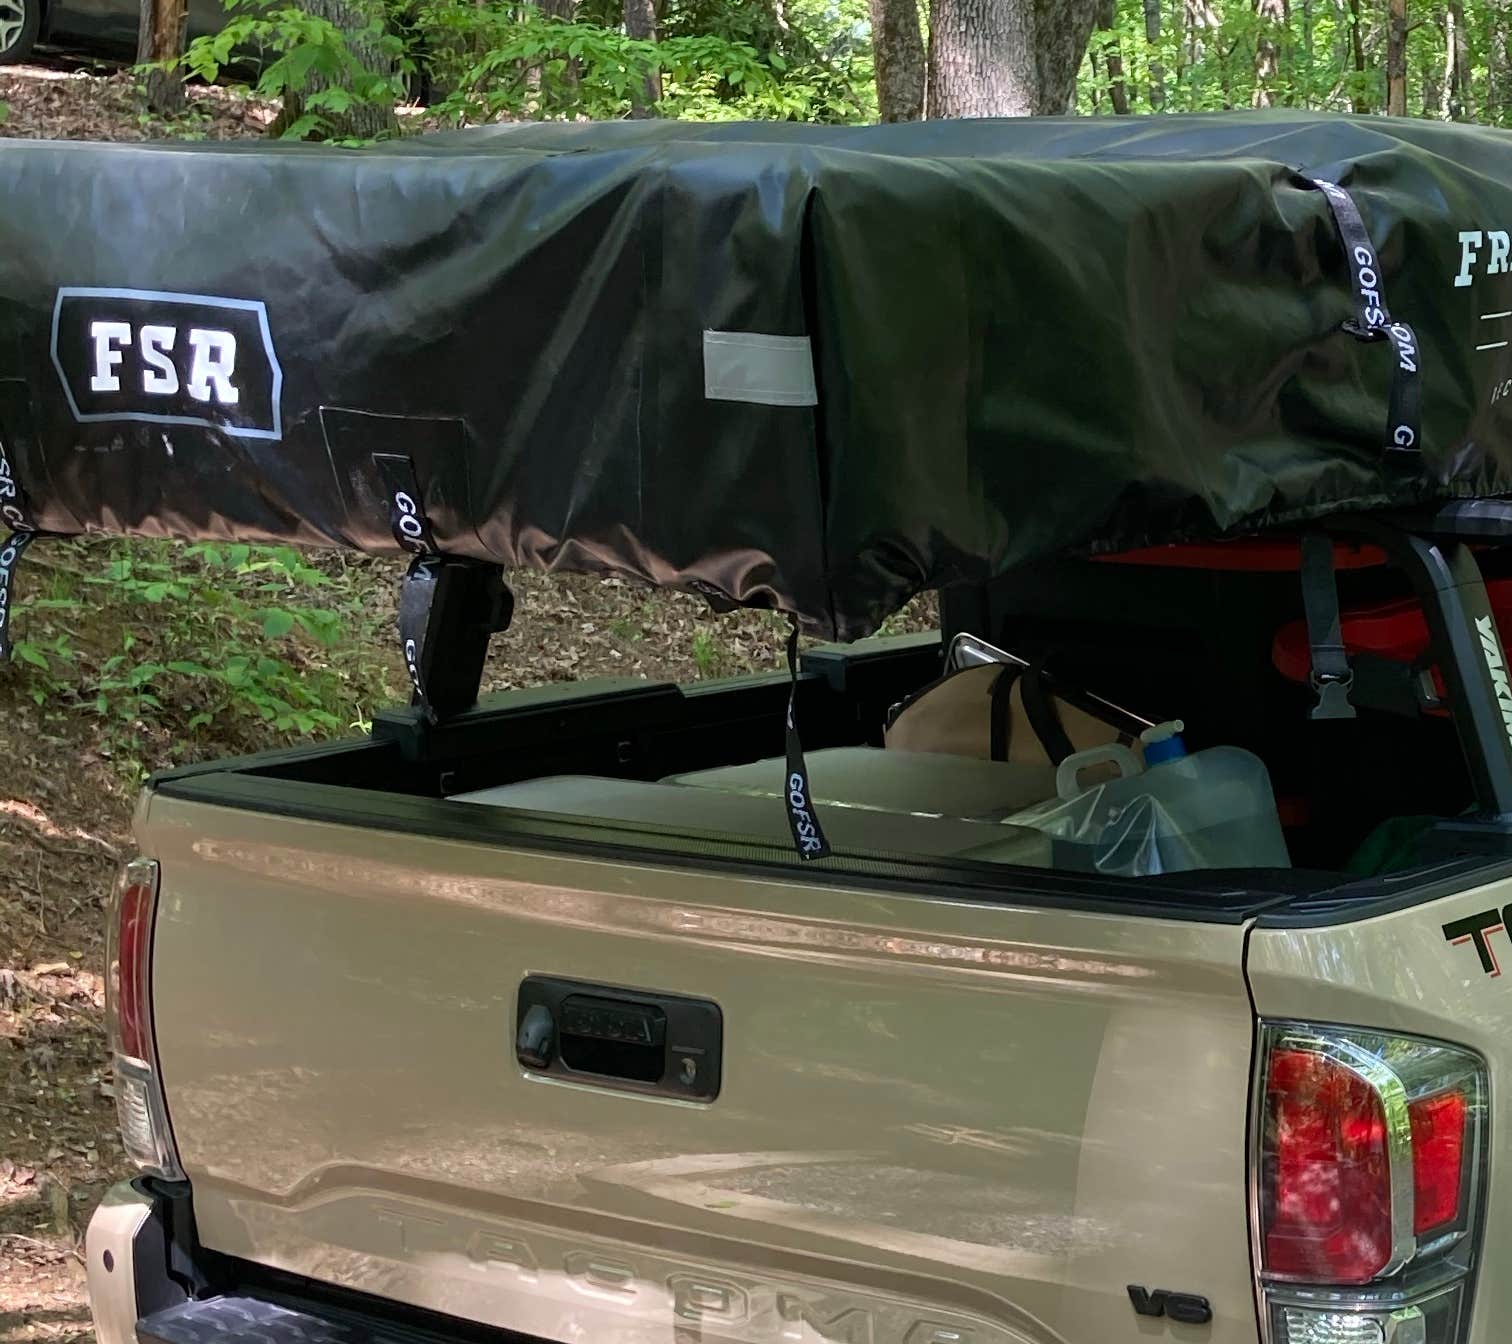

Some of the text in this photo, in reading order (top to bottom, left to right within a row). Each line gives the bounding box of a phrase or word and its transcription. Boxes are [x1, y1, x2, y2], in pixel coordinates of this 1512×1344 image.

[1354, 246, 1391, 329] GOFS
[91, 321, 239, 404] FSR
[1127, 1284, 1213, 1324] V6
